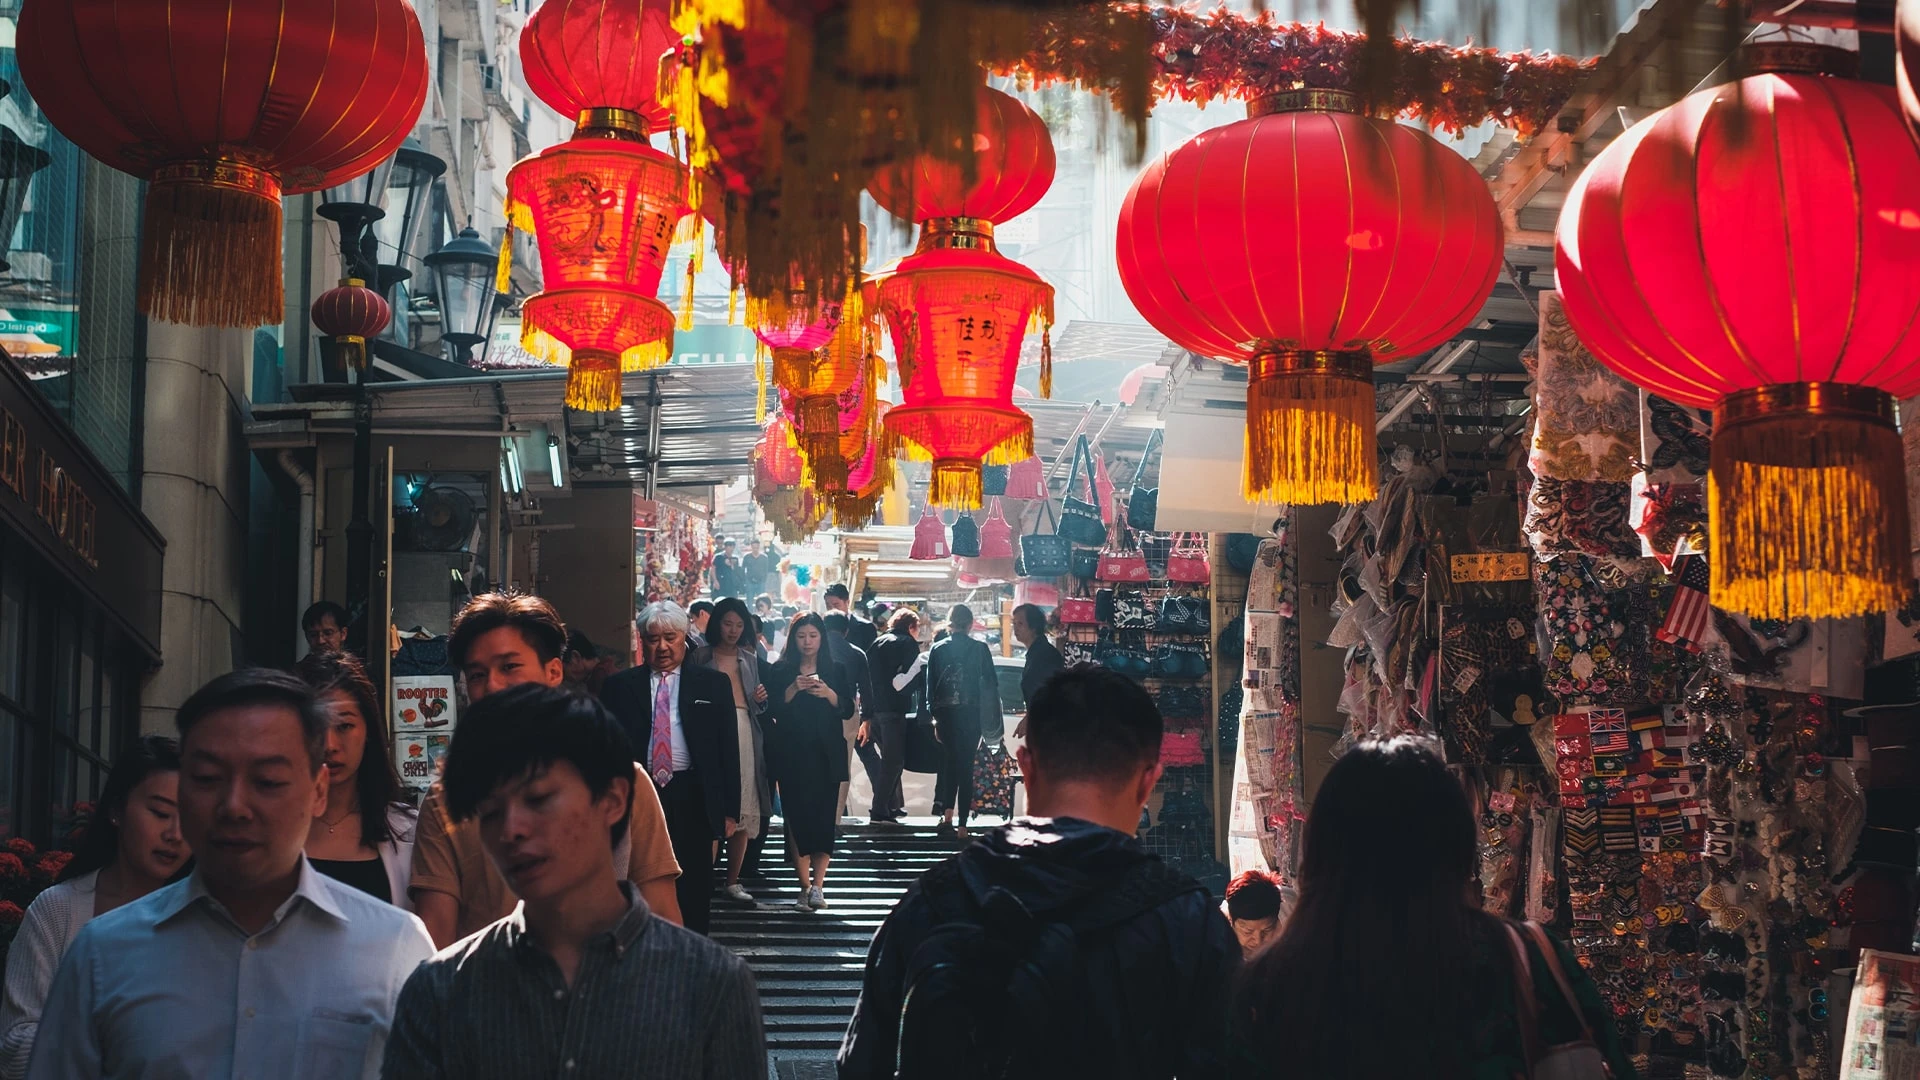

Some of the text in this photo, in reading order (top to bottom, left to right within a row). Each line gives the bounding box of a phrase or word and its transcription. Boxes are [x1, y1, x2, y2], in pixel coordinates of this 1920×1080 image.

[0, 404, 98, 567] ER HOTEL
[397, 688, 448, 700] ROOSTER
[403, 768, 428, 777] KING
